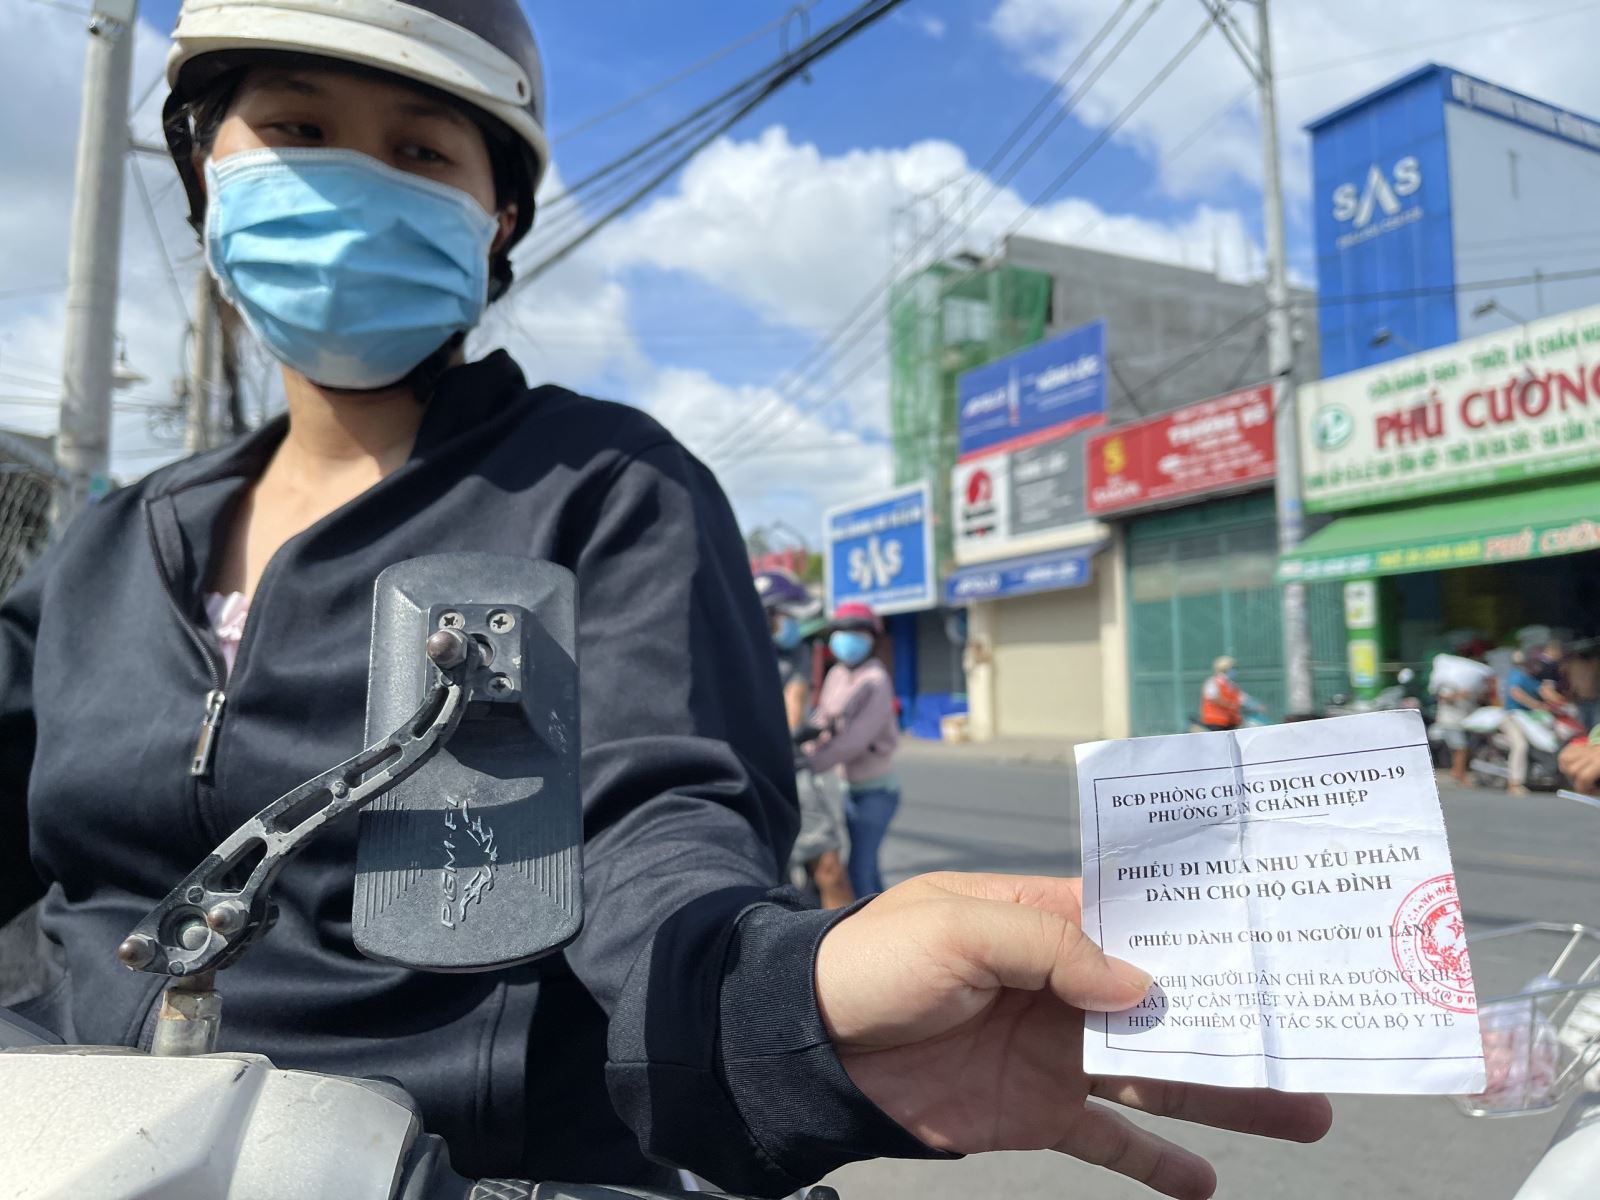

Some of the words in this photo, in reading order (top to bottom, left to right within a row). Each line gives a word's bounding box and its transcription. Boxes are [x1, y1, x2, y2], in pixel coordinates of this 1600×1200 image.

[1332, 155, 1422, 228] SAS
[1375, 390, 1445, 448] PHÚ
[849, 537, 902, 590] SAS
[1112, 794, 1145, 808] BCĐ
[1150, 787, 1206, 804] PHÒNG
[1270, 775, 1315, 794] DỊCH
[1320, 766, 1405, 786] COVID-19
[1148, 804, 1218, 823] PHƯỜNG
[1255, 793, 1320, 812] CHÁNH
[1324, 789, 1368, 806] HIỆP
[438, 795, 459, 931] PGM-FI
[1118, 861, 1174, 881] PHIẾU
[1180, 861, 1201, 876] ĐI
[1205, 859, 1251, 875] MUA
[1256, 855, 1298, 872] NHU
[1304, 848, 1349, 869] YẾU
[1354, 843, 1421, 865] PHẨM
[1145, 883, 1201, 902] DÀNH
[1206, 884, 1250, 900] CHO
[1256, 880, 1286, 901] HỘ
[1291, 880, 1331, 896] GIA
[1336, 873, 1392, 893] ĐÌNH
[1187, 930, 1233, 945] DÀNH
[1237, 930, 1273, 943] CHO
[1276, 930, 1292, 943] 01
[1298, 924, 1362, 942] NGƯỜI/
[1366, 926, 1383, 939] 01
[1191, 970, 1243, 987] NGƯỜI
[1247, 969, 1281, 986] DÂN
[1285, 969, 1315, 986] CHỈ
[1319, 972, 1344, 985] RA
[1348, 967, 1414, 985] ĐƯỜNG
[1418, 969, 1449, 982] KHI
[1136, 994, 1168, 1010] HẬT
[1172, 994, 1195, 1010] SỰ
[1198, 992, 1232, 1008] CẦN
[1235, 990, 1280, 1007] THIẾT
[1284, 991, 1310, 1007] VÀ
[1313, 990, 1355, 1007] ĐẢM
[1359, 989, 1397, 1006] BẢO
[1128, 1015, 1166, 1029] HIỆN
[1170, 1012, 1235, 1028] NGHIÊM
[1240, 1014, 1271, 1029] QUY
[1315, 1015, 1337, 1028] 5K
[1341, 1012, 1380, 1028] CỦA
[1384, 1013, 1409, 1031] BỘ
[1413, 1014, 1426, 1027] Y
[1430, 1009, 1455, 1027] TẾ
